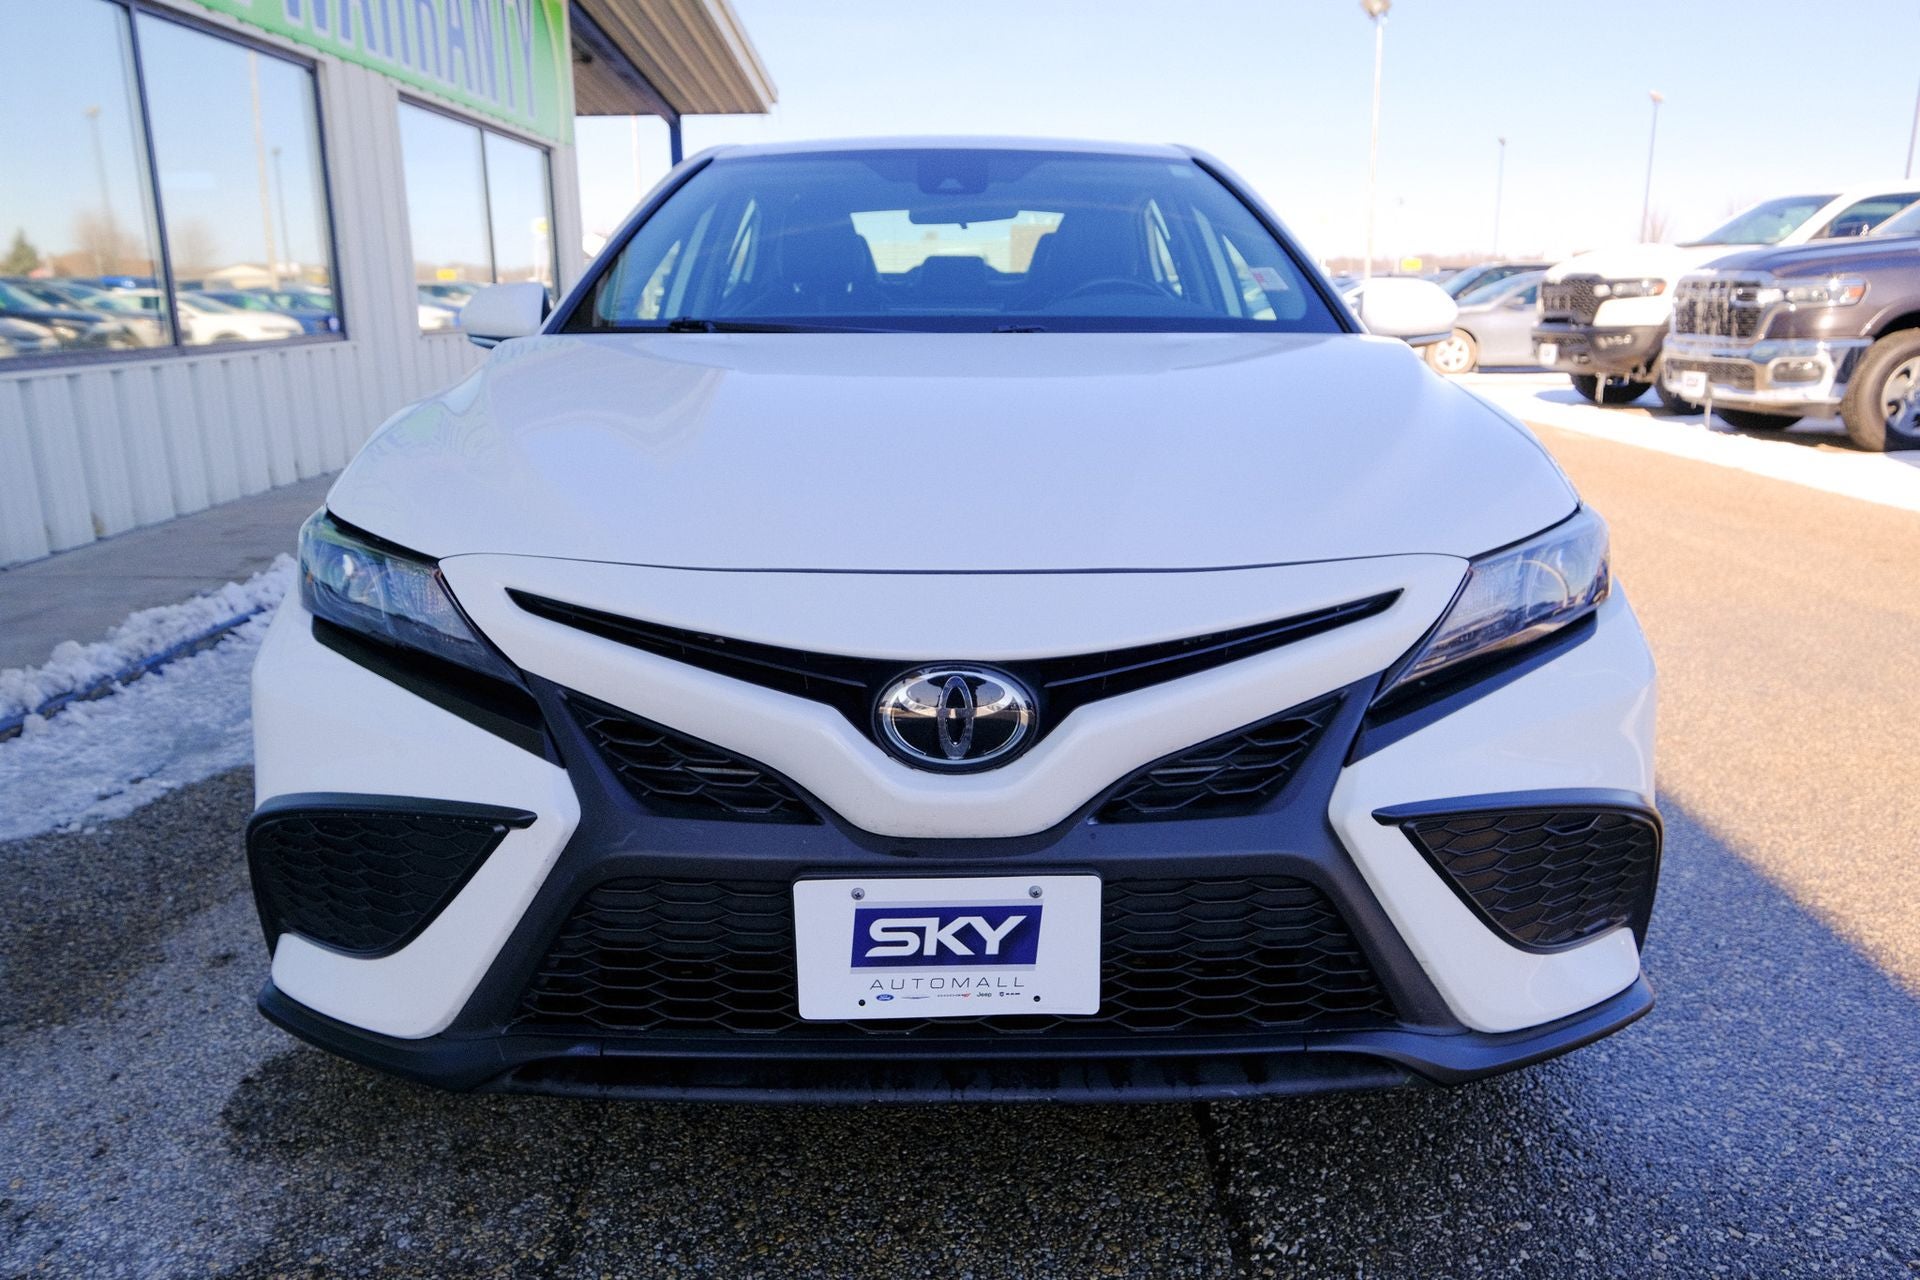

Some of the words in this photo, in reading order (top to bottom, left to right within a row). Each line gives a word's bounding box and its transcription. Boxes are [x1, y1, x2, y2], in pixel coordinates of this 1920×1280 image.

[284, 0, 536, 119] RANTY
[865, 915, 1028, 957] SKY
[869, 976, 1025, 991] AUTOMALL
